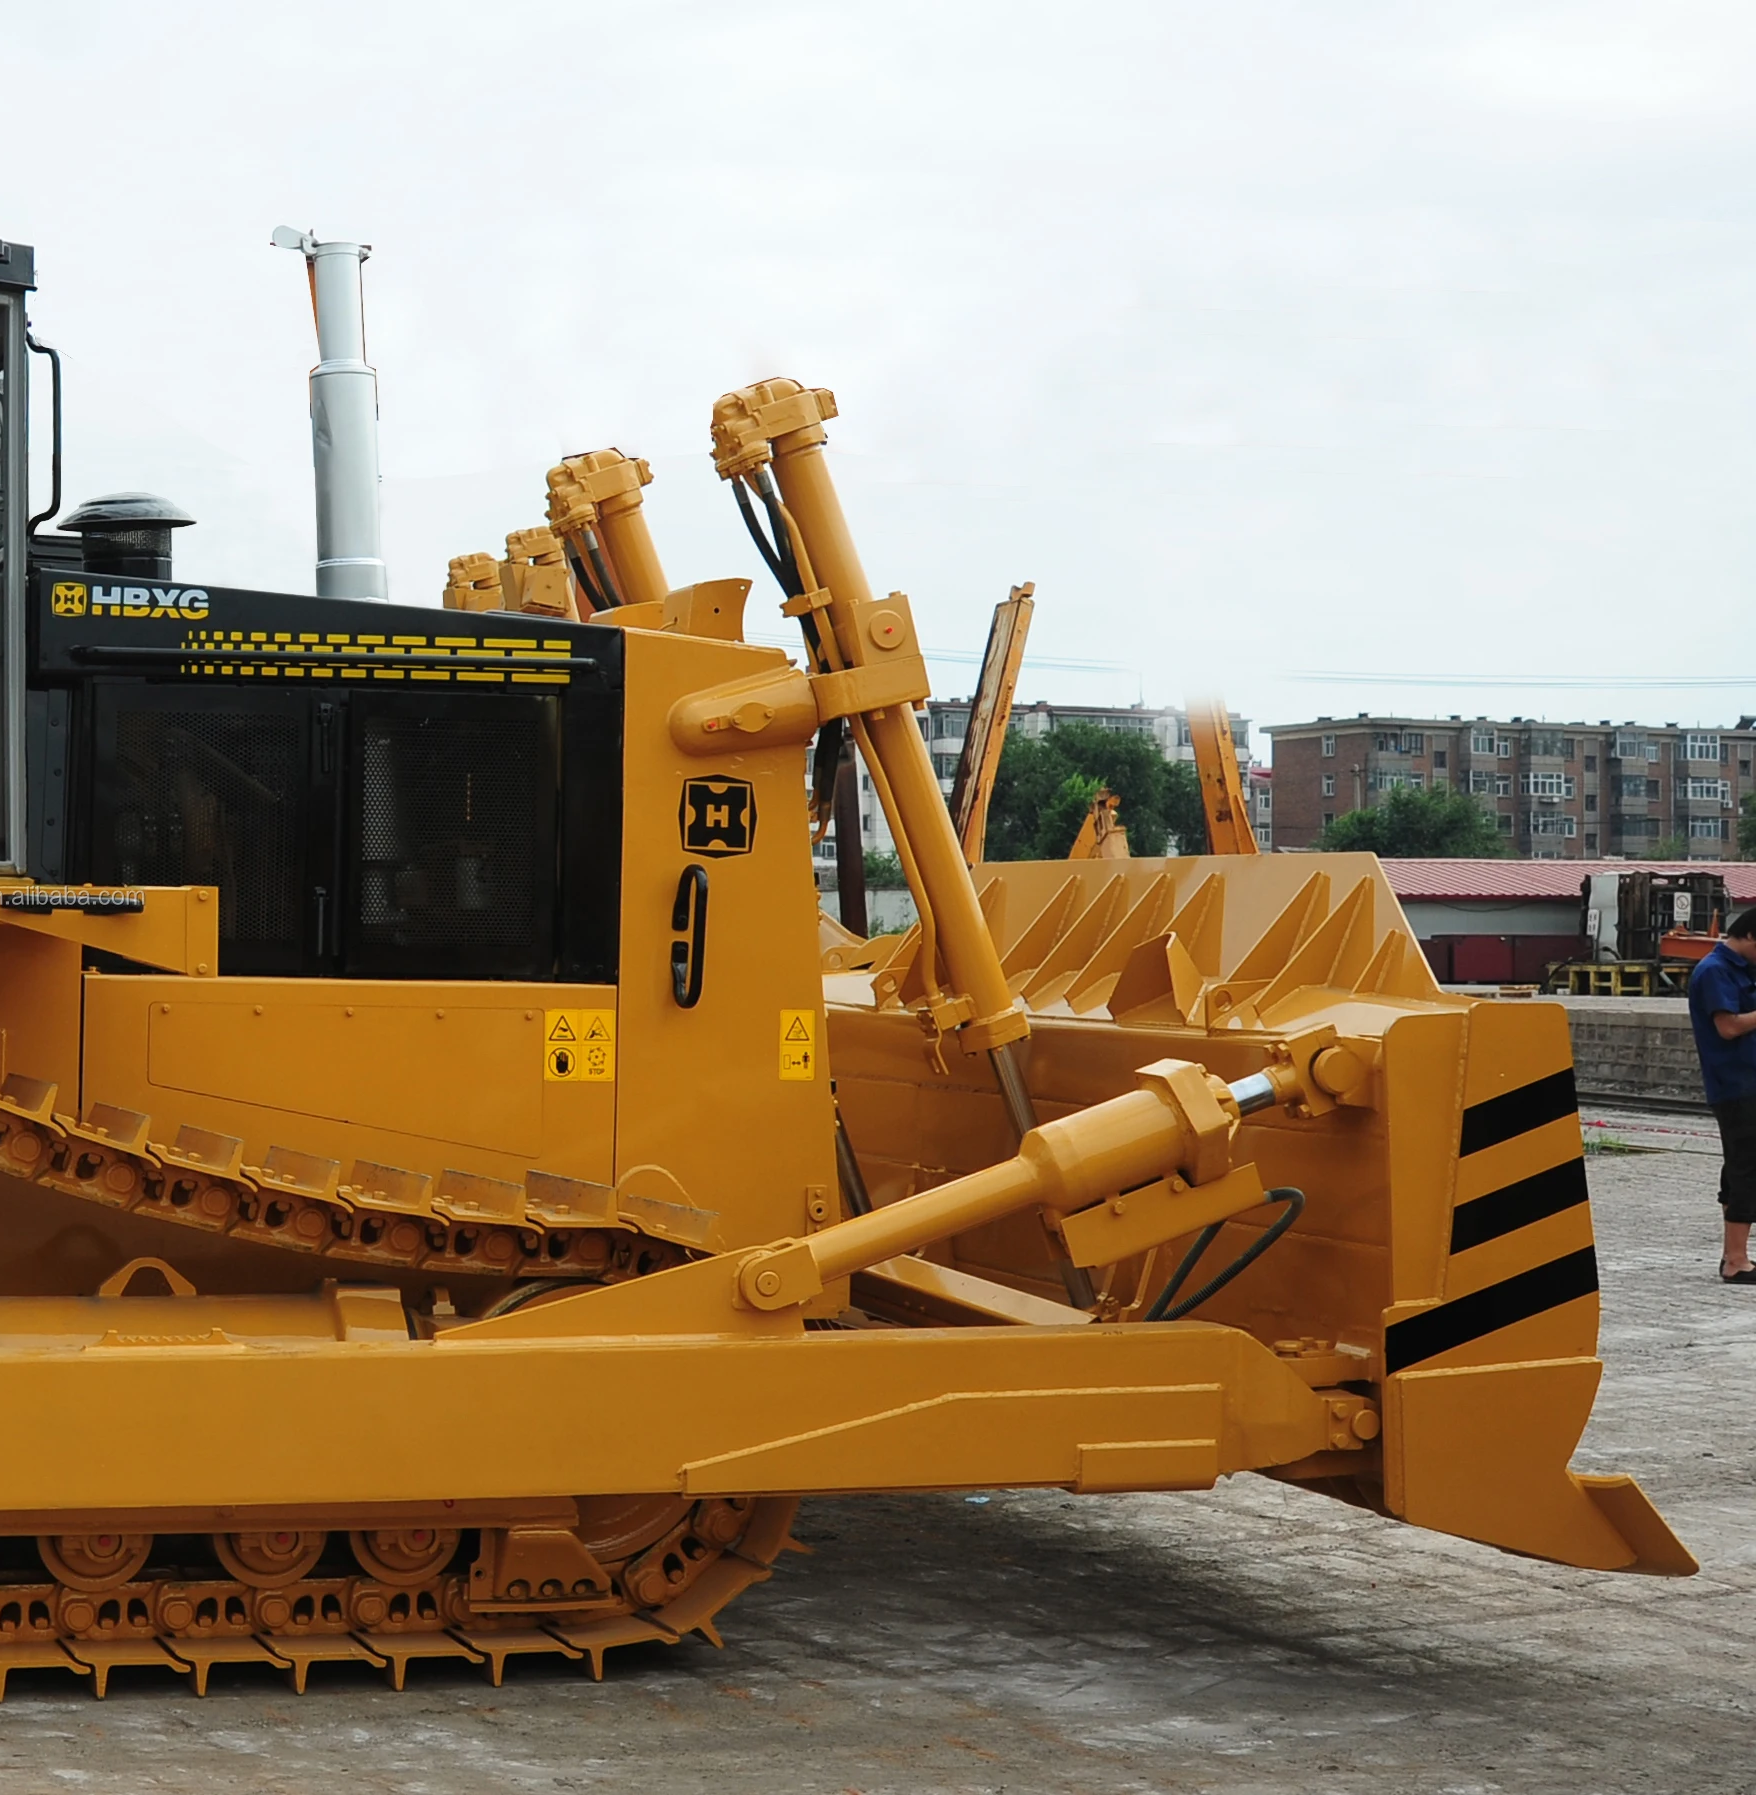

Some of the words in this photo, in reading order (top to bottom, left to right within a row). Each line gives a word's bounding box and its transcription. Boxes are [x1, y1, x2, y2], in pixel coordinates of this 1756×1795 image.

[91, 585, 210, 620] HBXG
[706, 804, 730, 828] H
[588, 1067, 605, 1076] STOP
